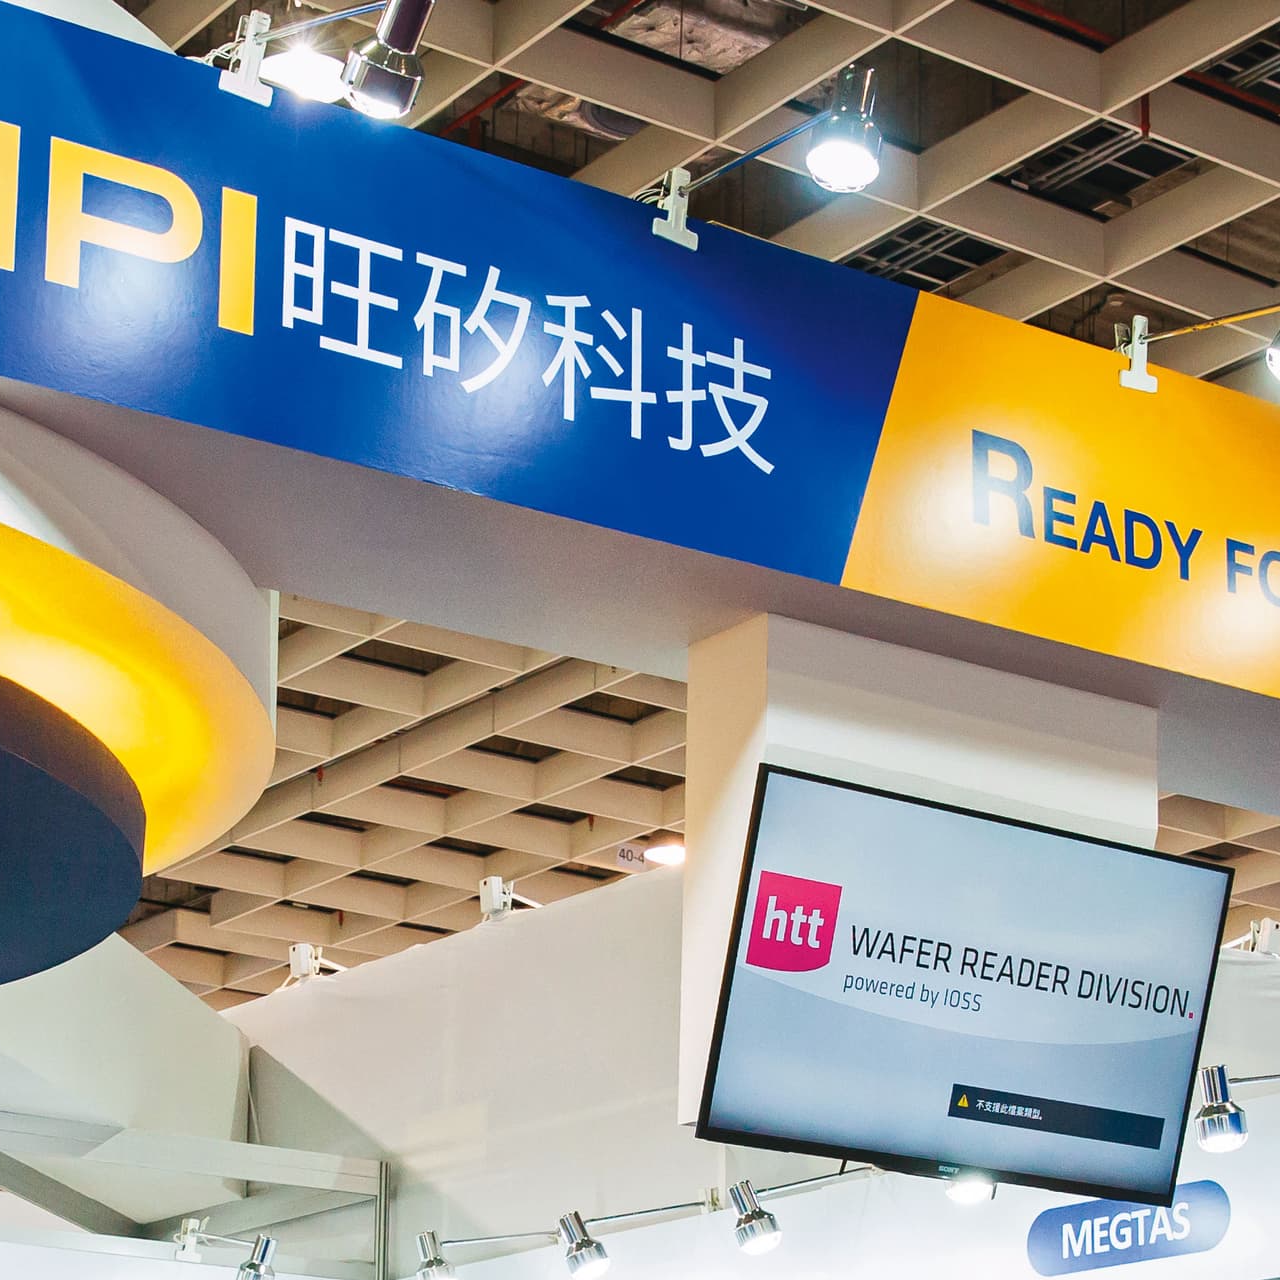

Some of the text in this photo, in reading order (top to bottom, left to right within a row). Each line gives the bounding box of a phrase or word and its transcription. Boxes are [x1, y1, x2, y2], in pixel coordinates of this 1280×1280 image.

[281, 216, 775, 475] 旺矽科技
[970, 428, 1203, 582] READY
[762, 895, 825, 950] htt
[843, 973, 916, 1001] powered
[920, 985, 940, 1009] by
[851, 925, 951, 974] WAFER
[960, 948, 1070, 997] READER
[1061, 1201, 1191, 1260] MEGTAS
